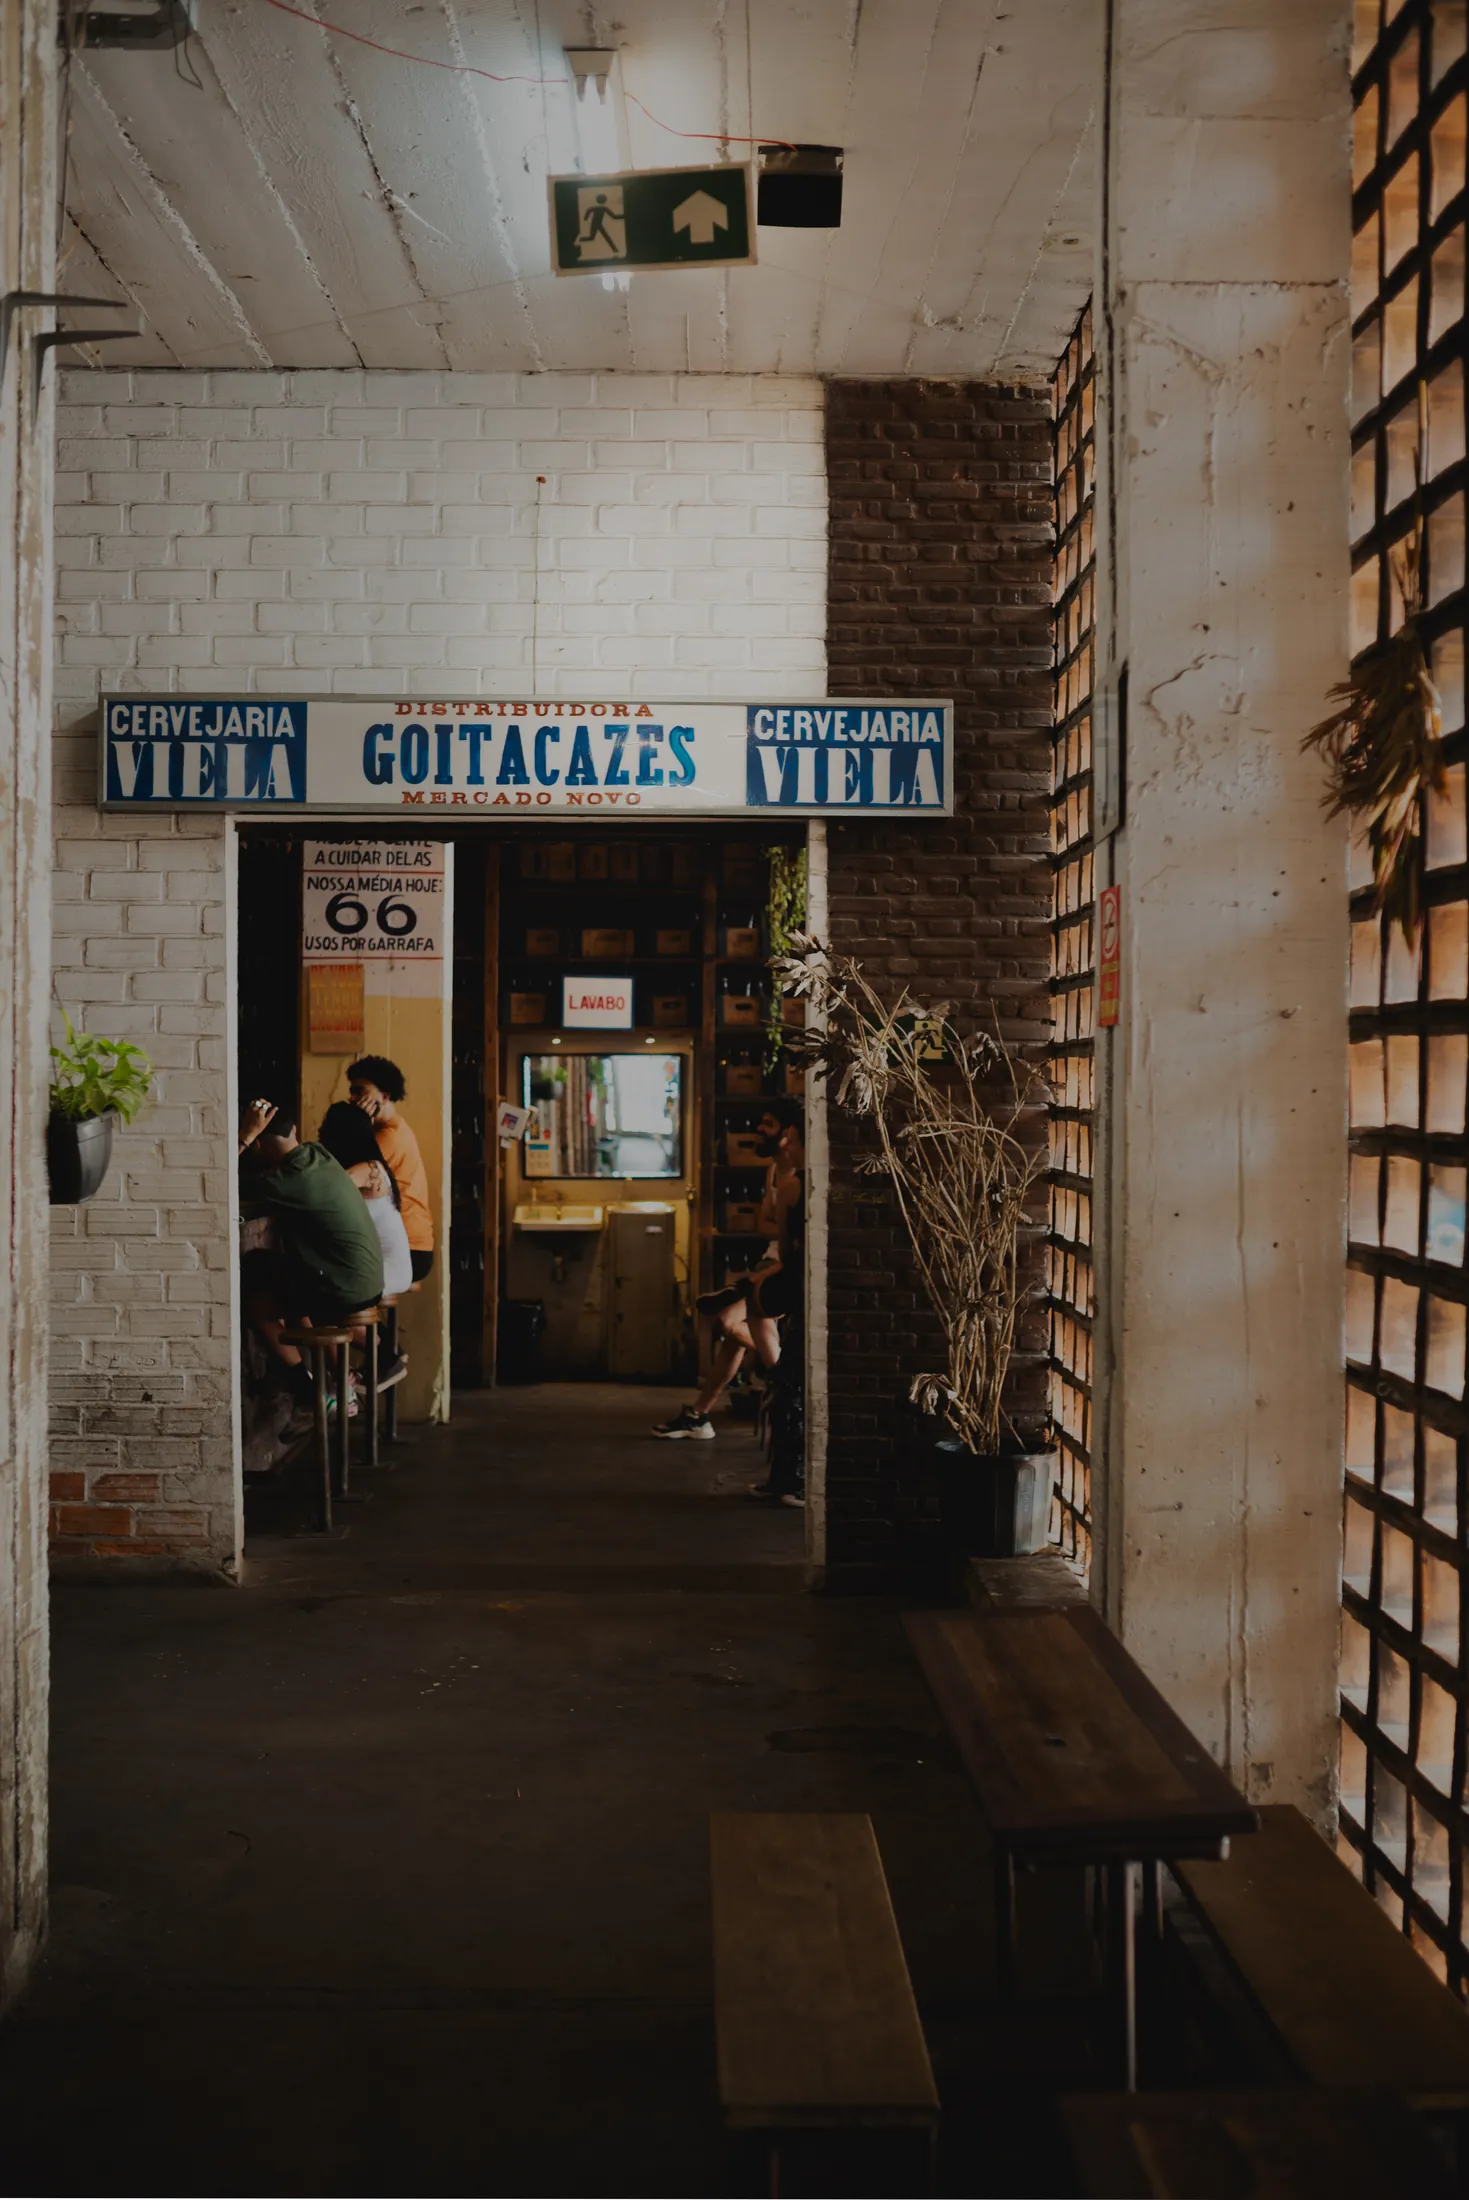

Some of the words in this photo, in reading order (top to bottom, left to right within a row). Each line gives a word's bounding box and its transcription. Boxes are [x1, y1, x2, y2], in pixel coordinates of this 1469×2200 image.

[111, 705, 295, 737] CERVEJARIA
[395, 702, 654, 717] DISTRIBUIDORA
[754, 709, 941, 742] CERVEJARIA
[363, 723, 696, 786] GOITACAZES
[110, 741, 295, 799] VIELA
[756, 746, 942, 804] VIELA
[401, 791, 552, 805] MERCADO
[566, 792, 642, 805] NOVO
[314, 850, 325, 865] A
[328, 850, 381, 865] CUIDAR
[386, 851, 432, 867] DELAS
[307, 876, 355, 891] NOSSA
[358, 874, 402, 892] MÉDIA
[405, 878, 442, 893] HOJE:
[325, 892, 417, 936] 66
[305, 936, 339, 951] USOS
[341, 936, 365, 951] POR
[368, 938, 434, 951] GARRAFA
[569, 994, 625, 1010] LAVABO
